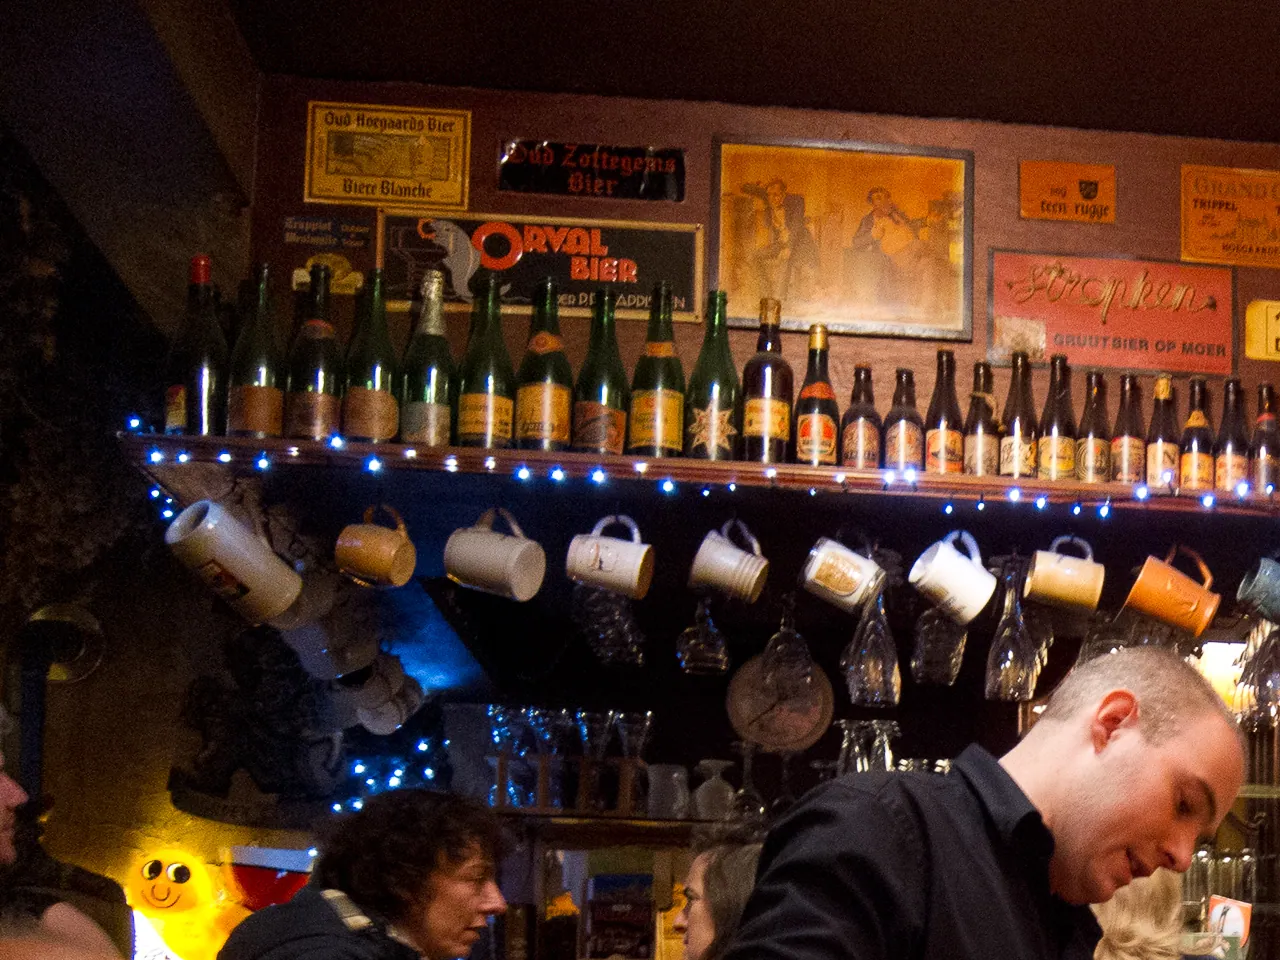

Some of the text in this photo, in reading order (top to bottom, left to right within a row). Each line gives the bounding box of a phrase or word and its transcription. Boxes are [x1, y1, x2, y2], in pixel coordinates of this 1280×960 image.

[324, 111, 351, 127] Oud
[428, 117, 456, 133] Bier
[561, 144, 676, 176] Zottegems
[380, 180, 433, 199] Blanche
[567, 172, 618, 195] Bier
[1193, 199, 1237, 213] TRIPPEL
[471, 222, 608, 270] ORVAL
[570, 256, 637, 283] BIER
[1053, 332, 1227, 358] GRUUTBIER OP MOER
